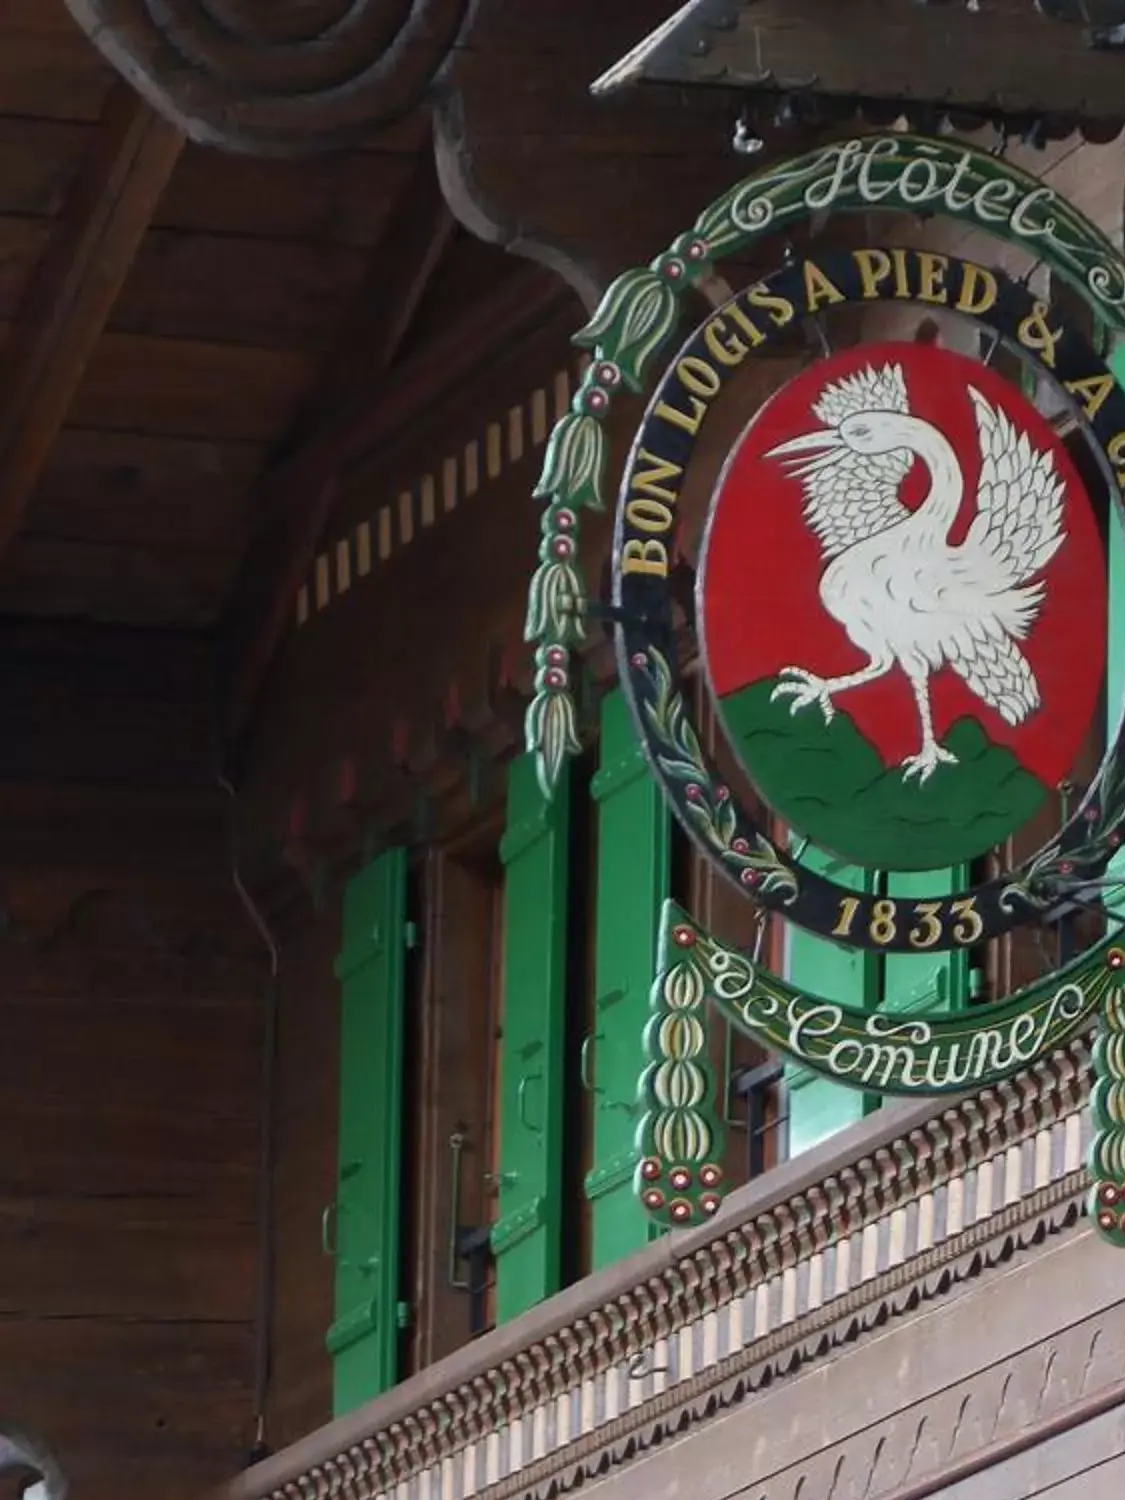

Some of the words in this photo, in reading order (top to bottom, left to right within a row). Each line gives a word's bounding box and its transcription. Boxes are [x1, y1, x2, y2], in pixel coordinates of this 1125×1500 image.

[622, 448, 684, 578] BON
[654, 282, 795, 437] LOGIS
[803, 260, 847, 312] A
[852, 248, 999, 315] PIED
[1017, 301, 1064, 369] &
[1064, 373, 1116, 423] A
[829, 895, 984, 947] 1833
